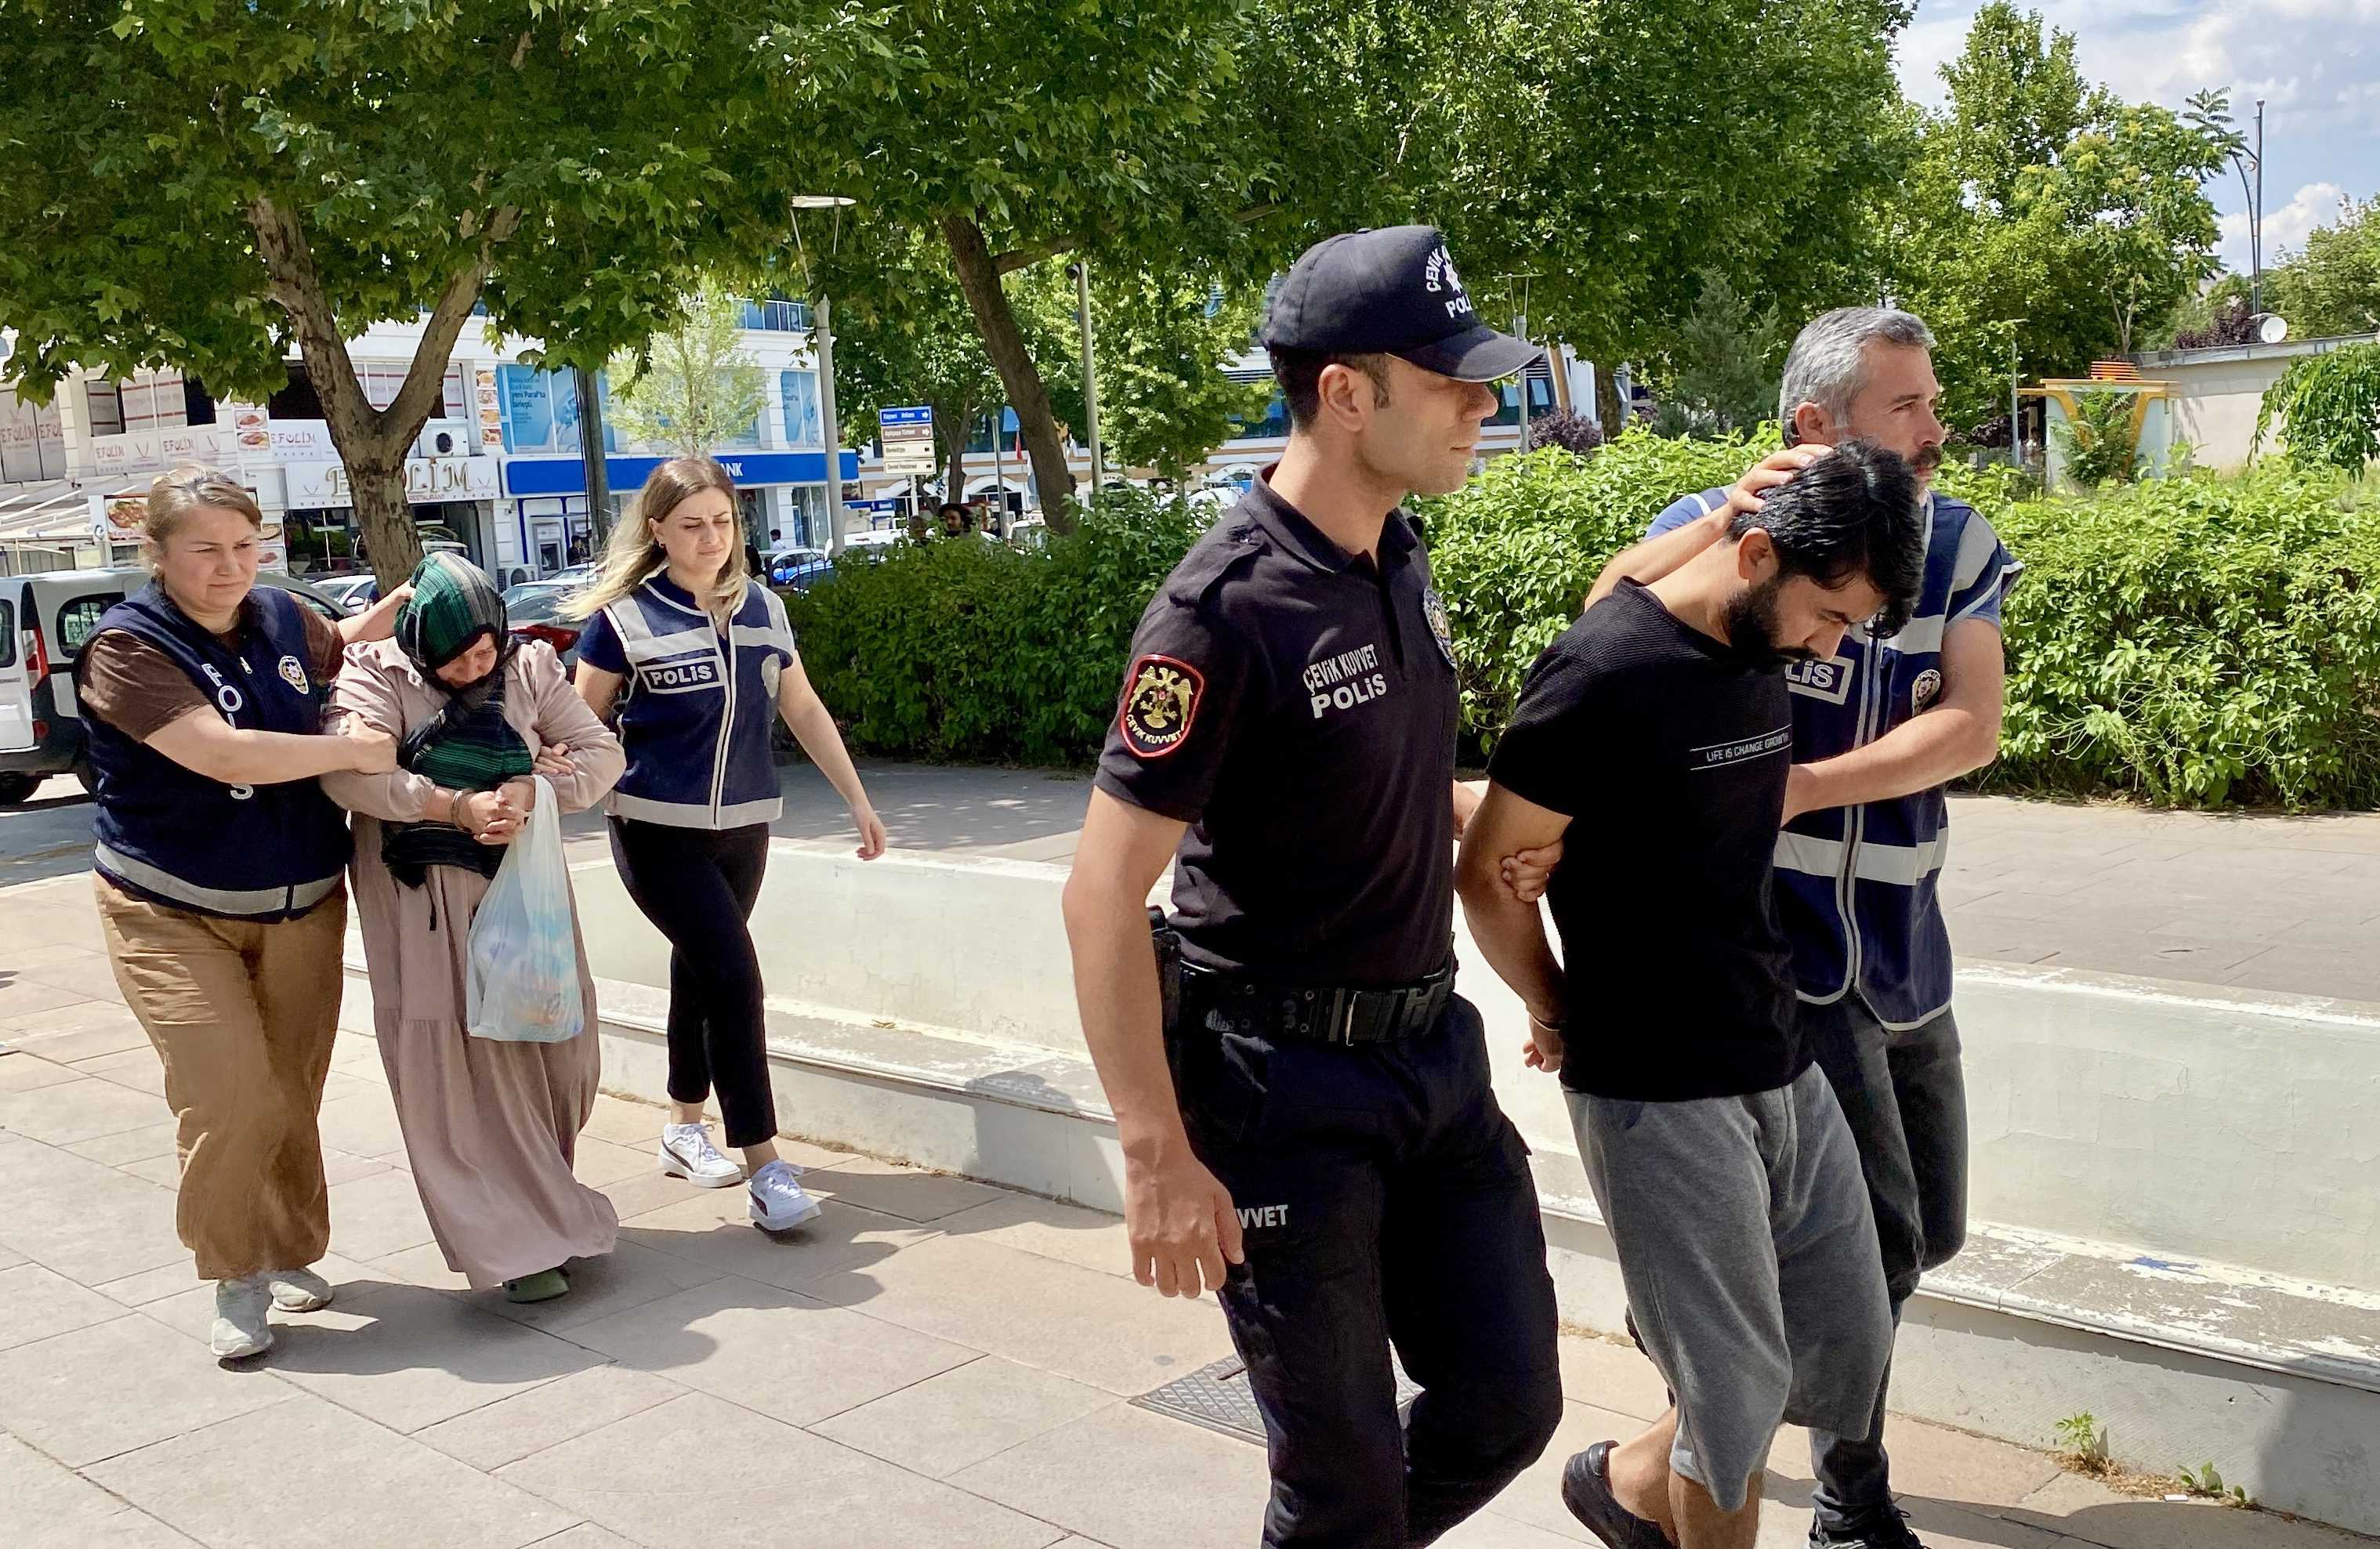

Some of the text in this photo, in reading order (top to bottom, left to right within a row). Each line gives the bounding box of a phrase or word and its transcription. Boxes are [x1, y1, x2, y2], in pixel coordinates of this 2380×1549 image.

[1337, 643, 1379, 678] KUVVET
[1706, 749, 1724, 762] LIFE
[1725, 747, 1733, 759] IS
[1733, 740, 1764, 757] CHANGE
[1236, 1203, 1288, 1229] VVET
